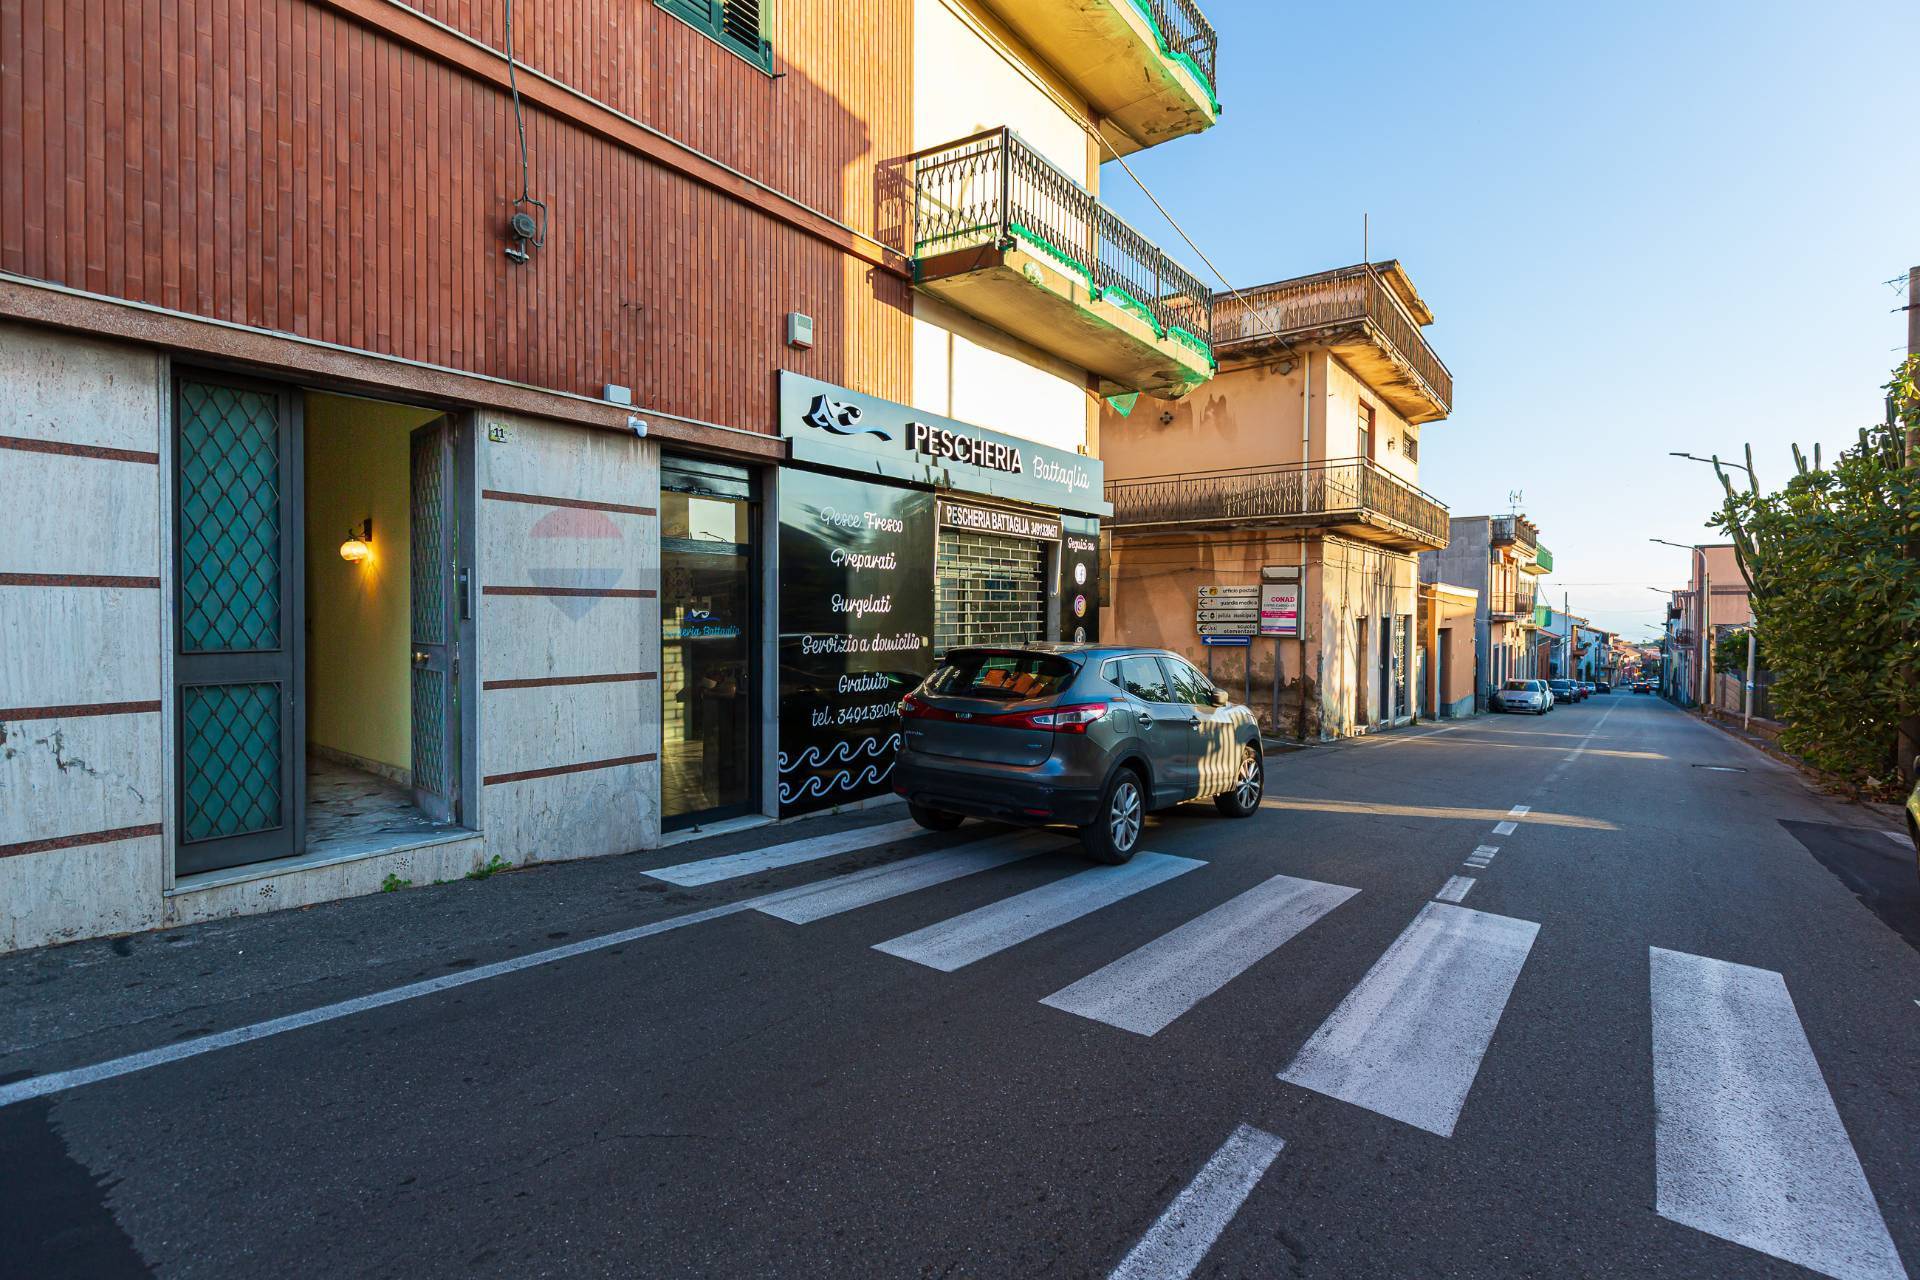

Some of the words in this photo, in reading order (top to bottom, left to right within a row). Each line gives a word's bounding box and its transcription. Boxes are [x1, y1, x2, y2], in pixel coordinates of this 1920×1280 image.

[494, 427, 505, 438] 11
[910, 422, 1024, 473] PESCHERIA
[1032, 454, 1090, 494] Battaglia
[820, 506, 861, 527] Pesce
[864, 511, 903, 533] Fresco
[946, 505, 991, 529] PESCHERIA
[991, 512, 1030, 535] BATTAGLIA
[830, 548, 897, 573] Preparati
[831, 593, 892, 618] Surgelati
[801, 633, 858, 655] Servizio
[859, 640, 871, 653] a
[872, 631, 920, 652] domicilio
[838, 671, 889, 694] Gratuito
[812, 705, 835, 727] tel.
